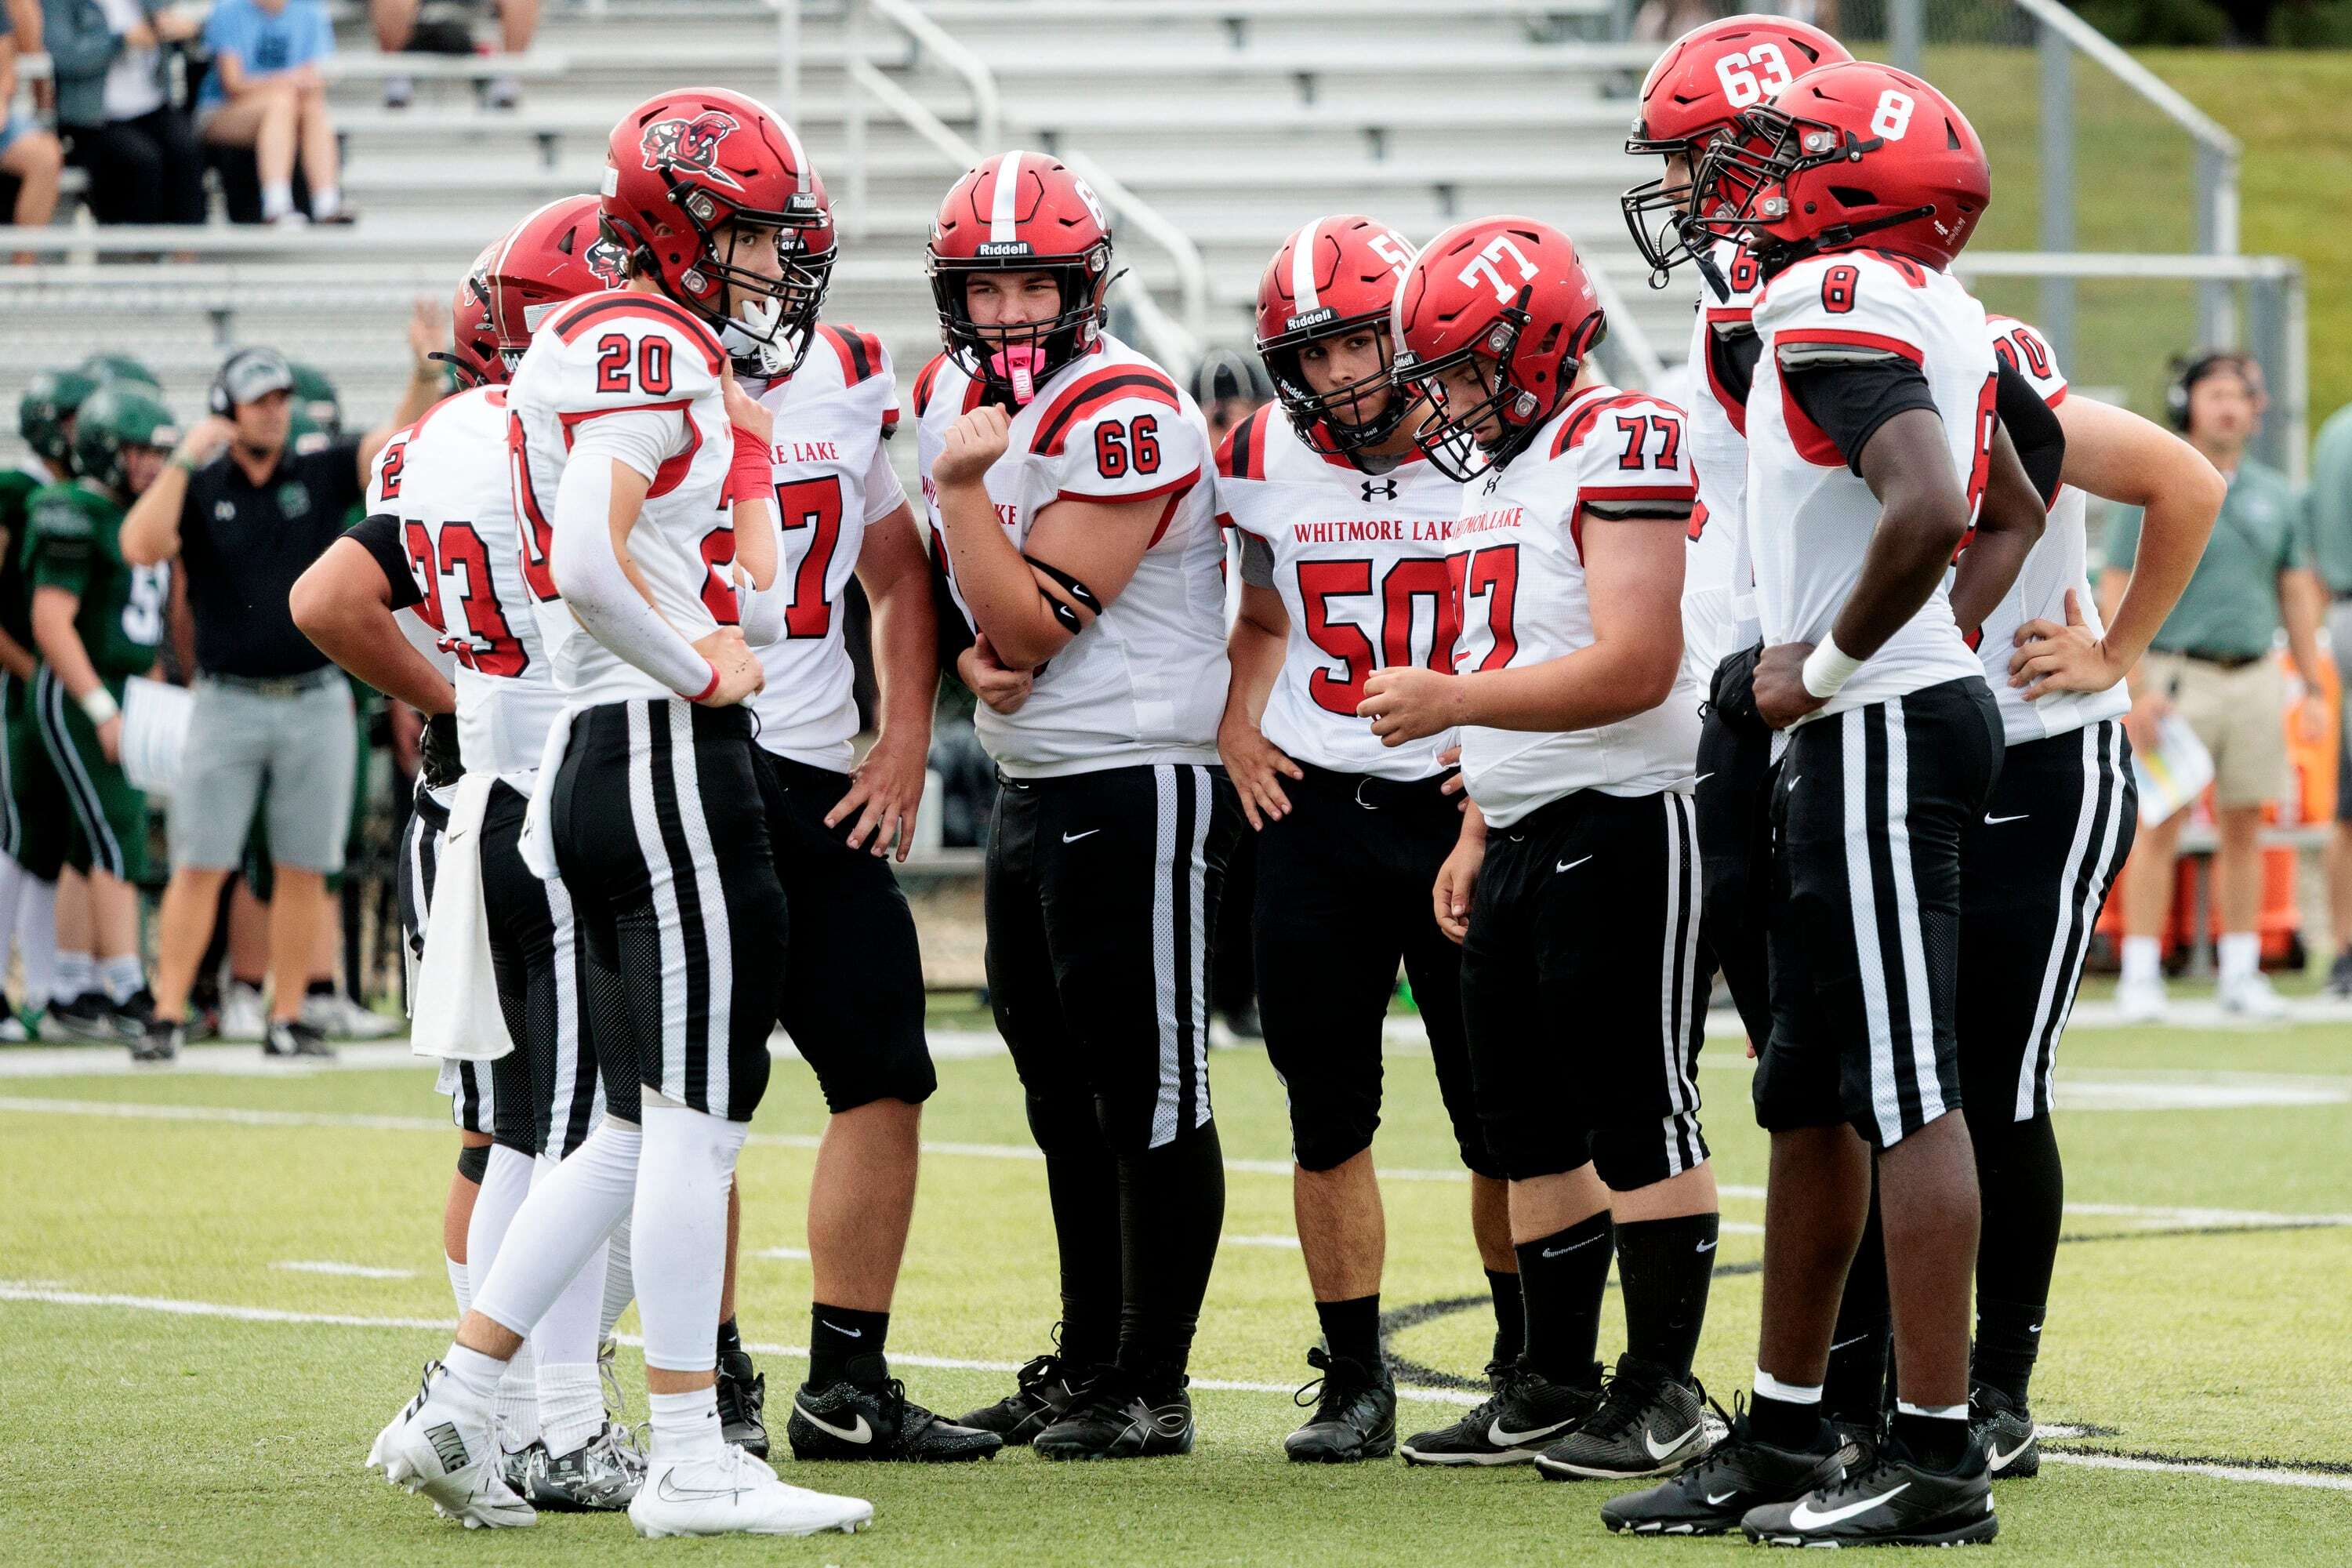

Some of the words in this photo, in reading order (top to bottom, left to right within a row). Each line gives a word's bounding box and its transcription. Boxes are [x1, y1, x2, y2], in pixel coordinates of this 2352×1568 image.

[1715, 42, 1794, 109] 63
[1871, 89, 1915, 142] 8
[980, 242, 1028, 256] Riddell
[1457, 235, 1540, 305] 77
[1821, 265, 1860, 314] 8
[1287, 309, 1332, 330] Riddell
[596, 332, 673, 395] 20
[793, 441, 840, 463] LAKE
[1094, 413, 1162, 479] 66
[1616, 415, 1680, 472] 77
[1294, 521, 1404, 543] WHITMORE
[1412, 521, 1453, 541] LAK
[1489, 507, 1523, 530] LAKE
[1296, 558, 1456, 718] 50
[424, 1421, 470, 1475] NIKE
